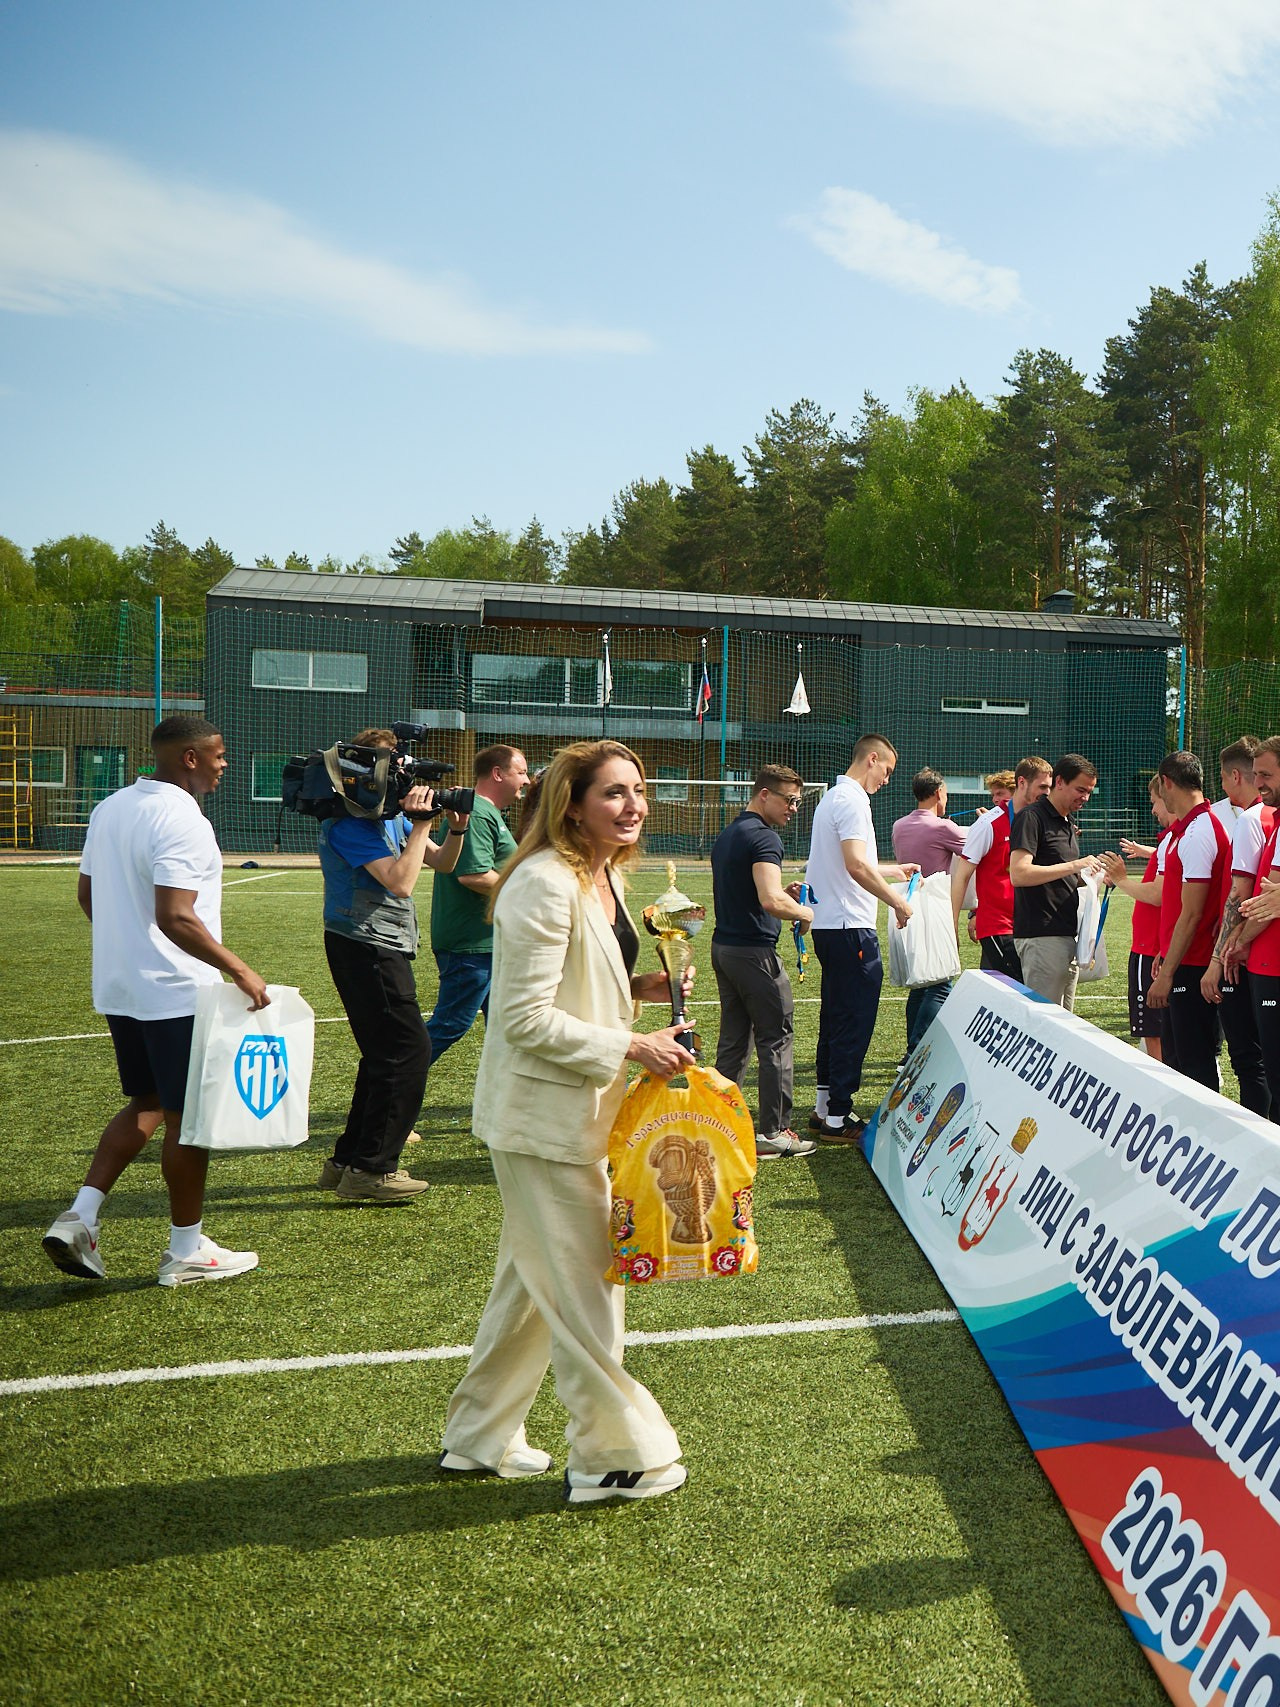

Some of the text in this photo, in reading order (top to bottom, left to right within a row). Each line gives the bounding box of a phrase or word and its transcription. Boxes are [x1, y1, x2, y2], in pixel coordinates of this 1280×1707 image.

[1261, 999, 1277, 1007] JAKO
[964, 1005, 1058, 1092] ПОБЕДИТЕЛЬ
[1047, 1061, 1122, 1140] КУБКА
[1110, 1102, 1240, 1220] РОССИИ
[1018, 1164, 1075, 1250] ЛИЦ
[1060, 1206, 1090, 1256] С
[1109, 1479, 1218, 1646] 2026
